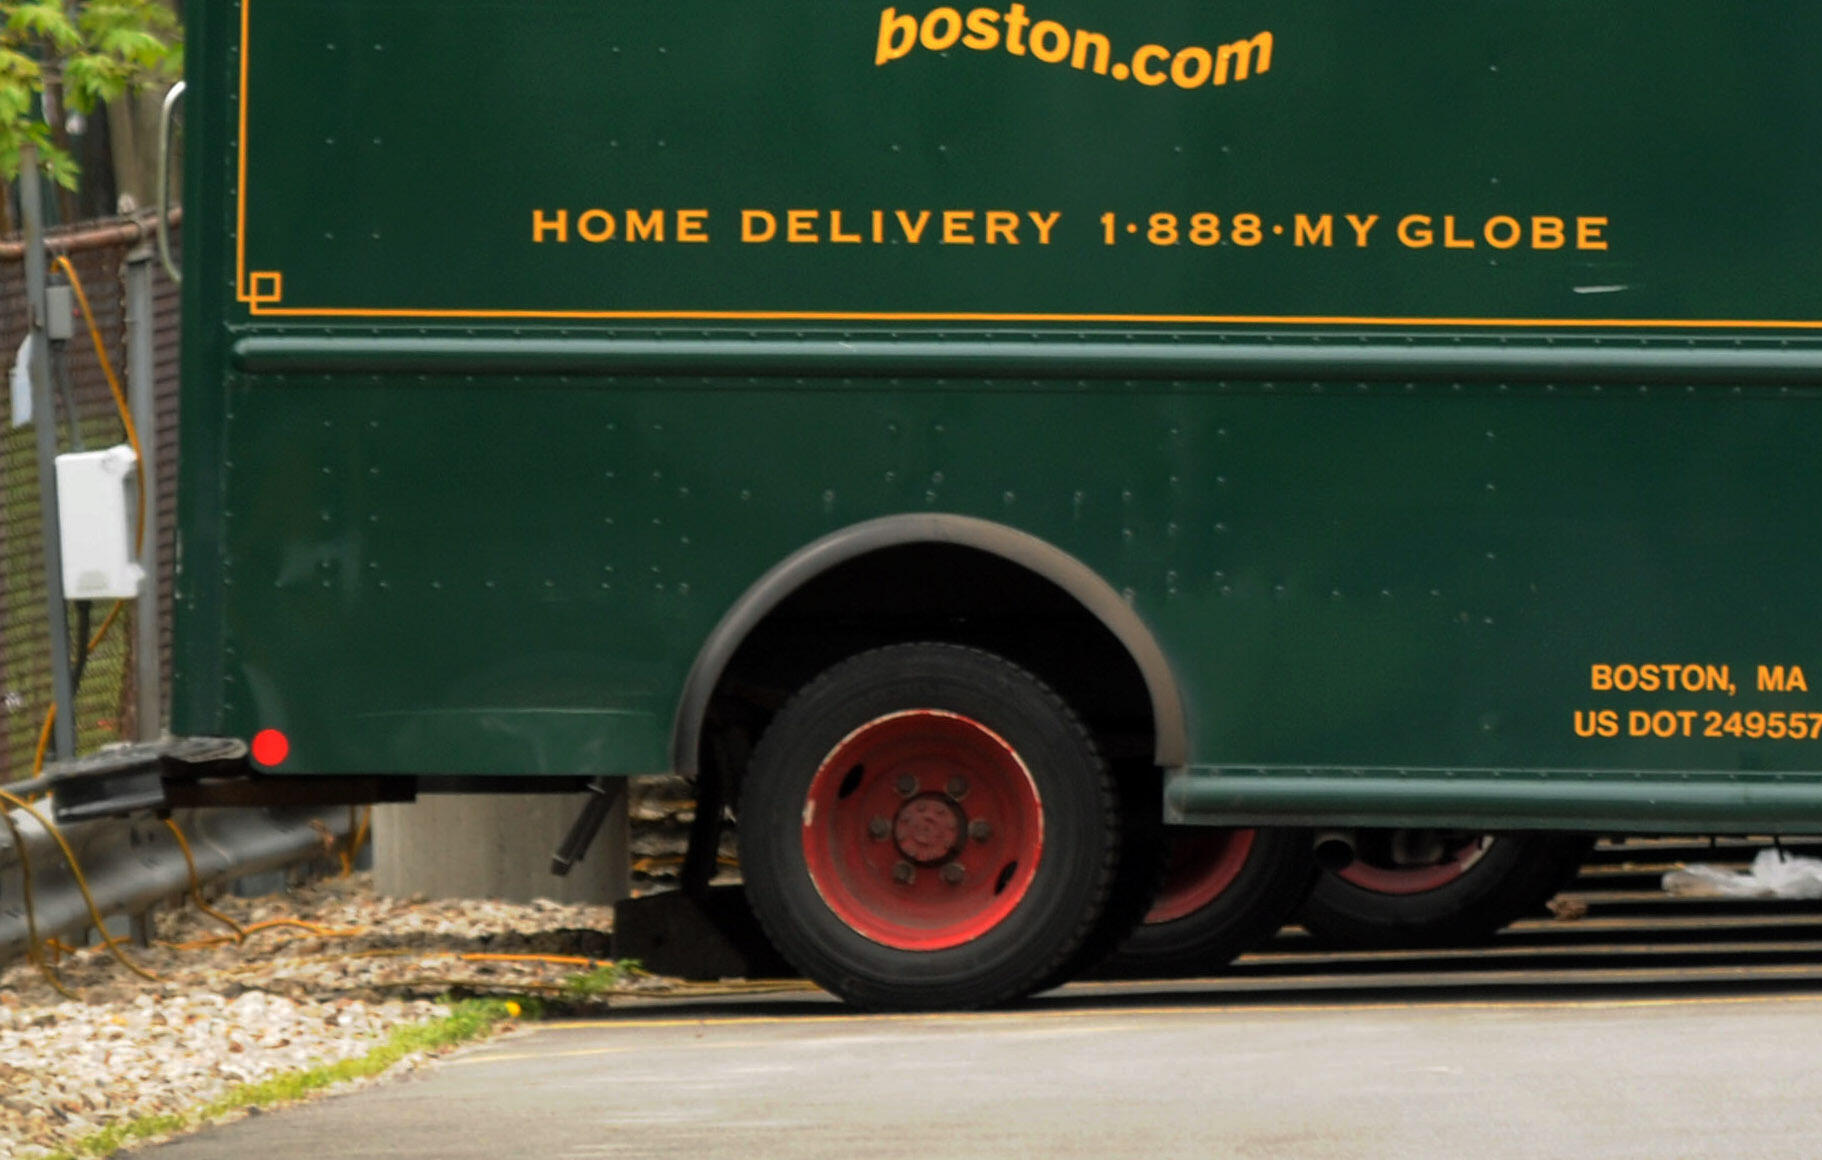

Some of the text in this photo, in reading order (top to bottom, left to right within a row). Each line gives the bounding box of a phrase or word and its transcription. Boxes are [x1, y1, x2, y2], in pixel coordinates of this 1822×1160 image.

[875, 2, 1274, 89] boston.com
[532, 208, 710, 243] HOME
[740, 209, 1062, 245] DELIVERY
[1396, 213, 1609, 251] GLOBE
[1591, 663, 1809, 696] BOSTON, MA
[1573, 709, 1620, 738] US
[1628, 709, 1699, 738] DOT
